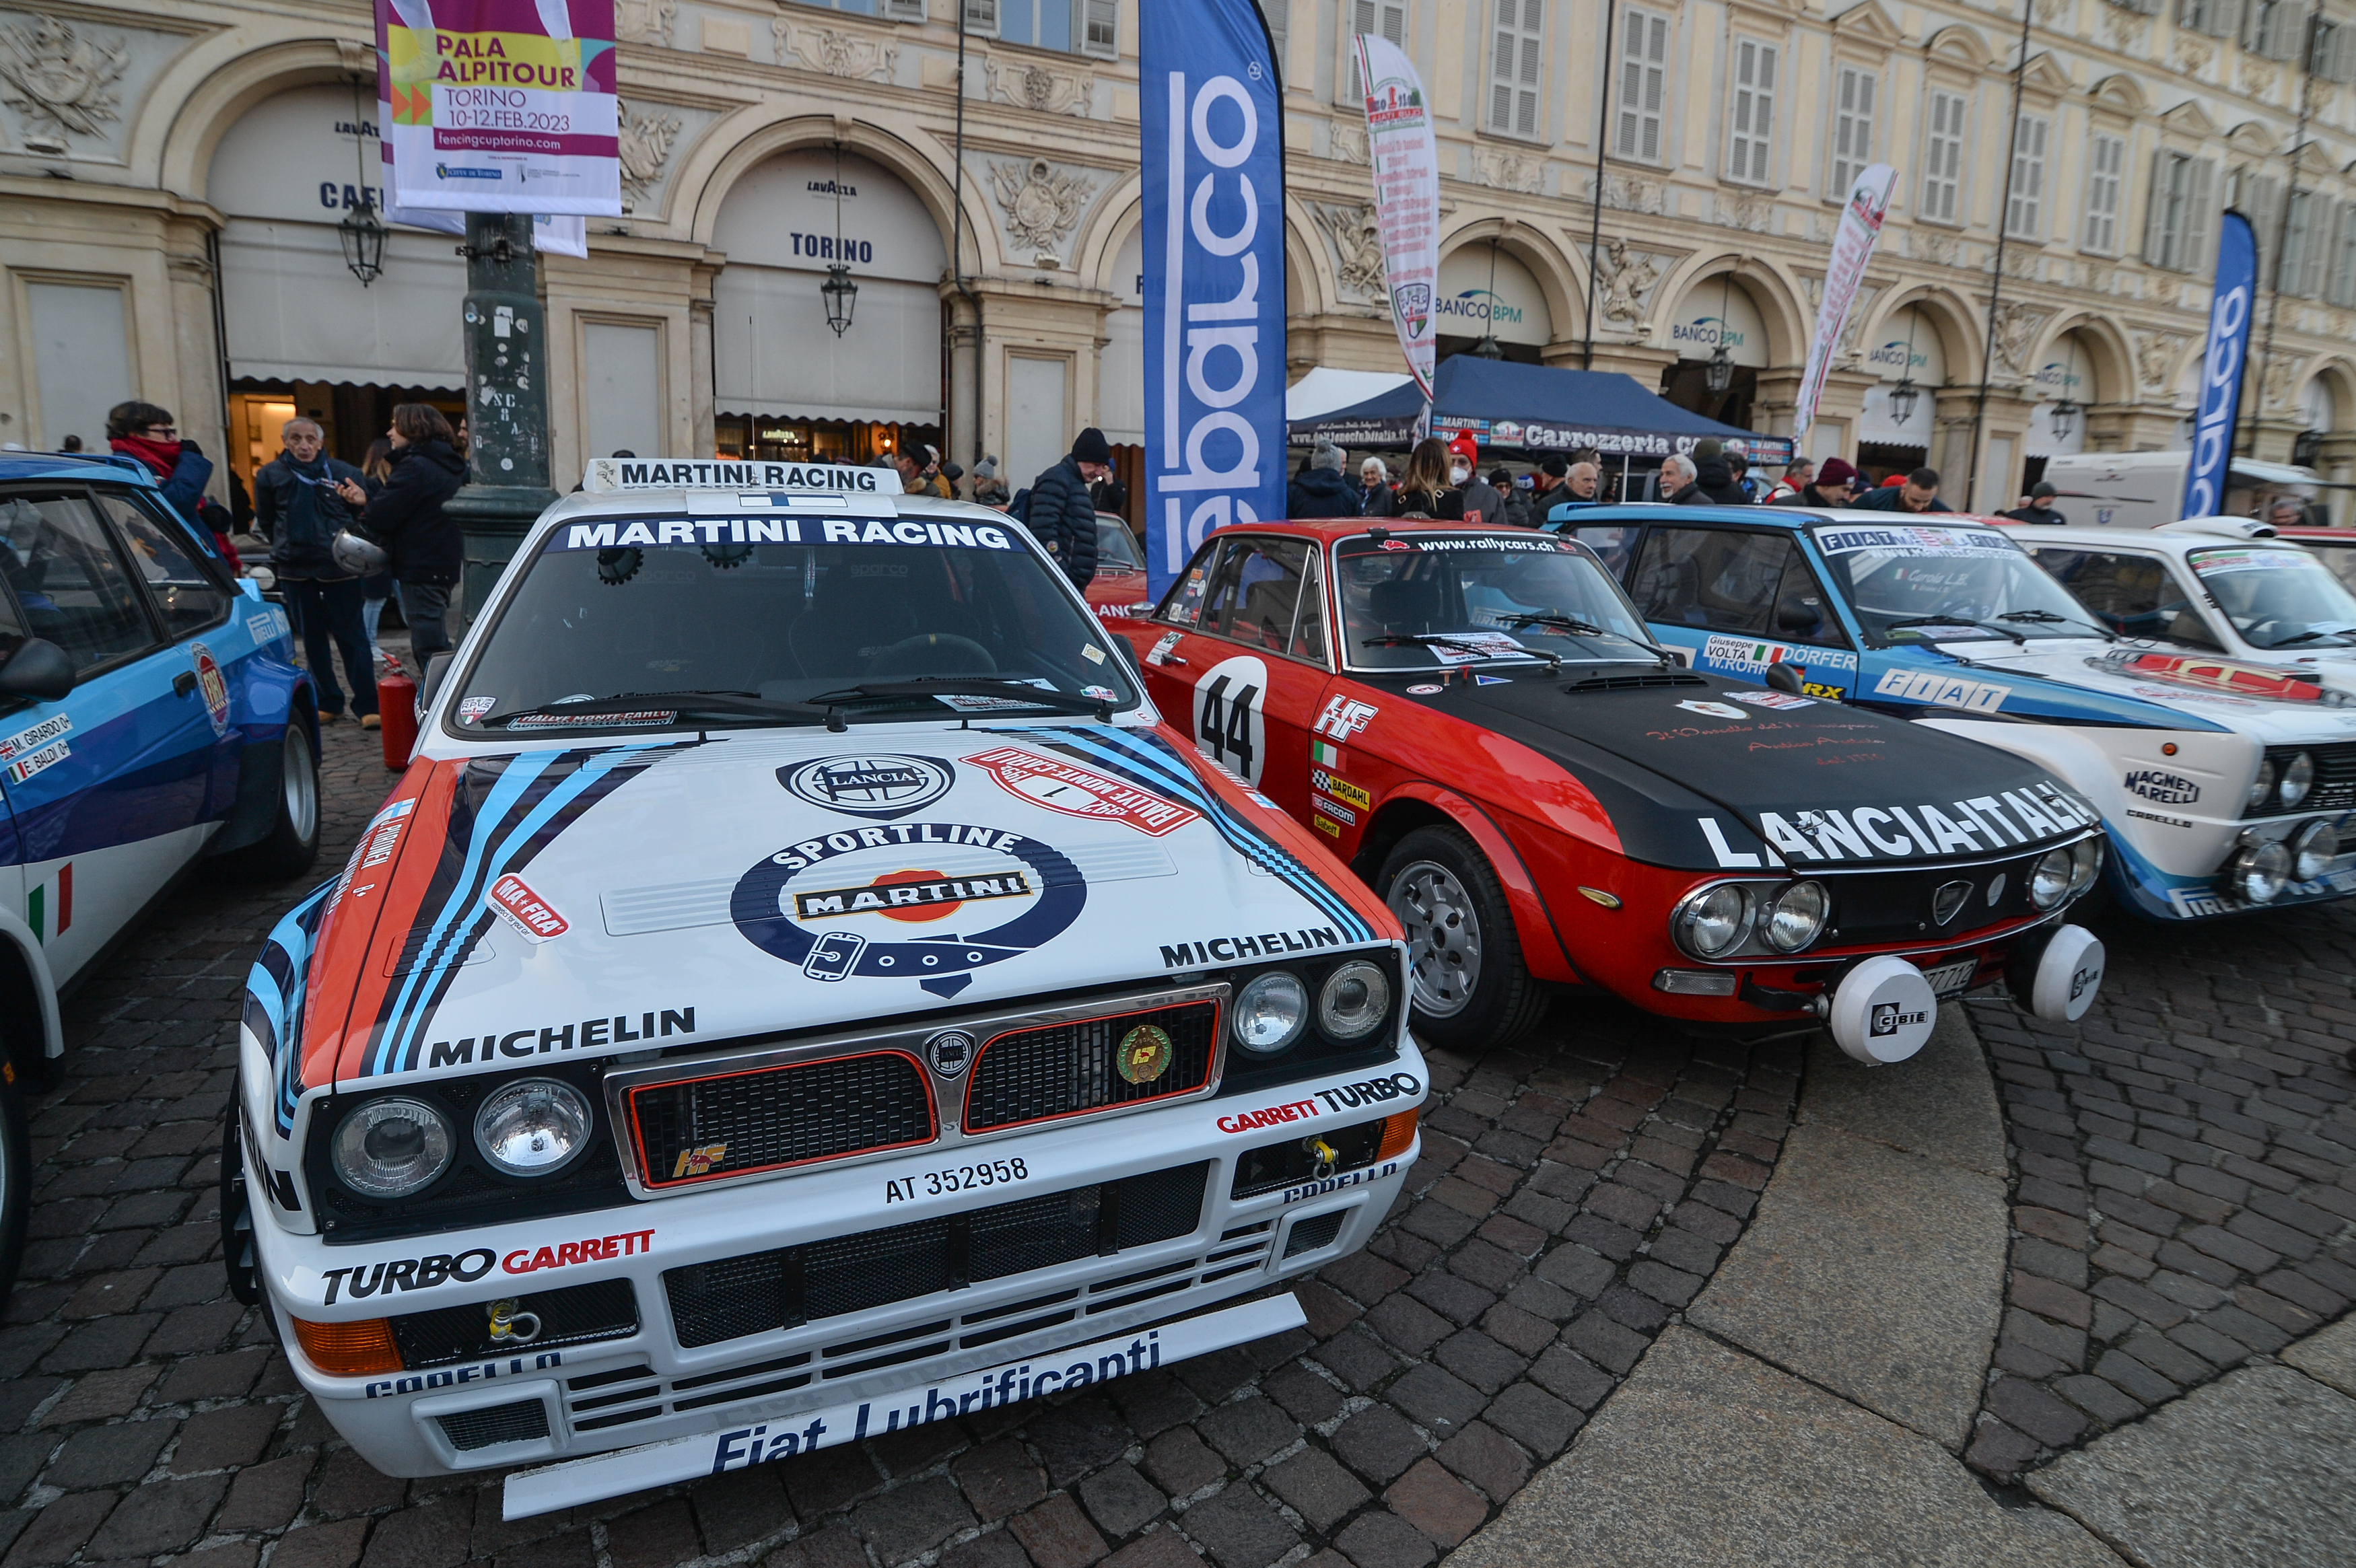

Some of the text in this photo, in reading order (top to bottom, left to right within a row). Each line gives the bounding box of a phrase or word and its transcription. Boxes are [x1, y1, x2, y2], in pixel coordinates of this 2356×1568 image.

[437, 34, 506, 58] PALA
[438, 60, 576, 87] ALPITOUR
[444, 88, 526, 108] TORINO
[449, 110, 569, 132] 10-12.FEB.2023
[438, 133, 561, 151] fencingcuptorino.com
[807, 180, 857, 196] LAVAZZA
[790, 232, 872, 263] TORINO
[1435, 297, 1490, 319] BANCO
[1492, 306, 1523, 324] BPM
[1673, 324, 1744, 346] BANCO BPM
[1441, 416, 1481, 429] MARTINI
[1525, 425, 1670, 454] Carrozzeria
[1757, 441, 1785, 450] MARTINI
[1756, 453, 1784, 462] RACING
[621, 463, 753, 487] MARTINI
[764, 464, 876, 491] RACING
[567, 520, 1010, 549] MARTINI RACING
[1418, 537, 1556, 553] www.rallycars.ch
[1820, 530, 1898, 552] FIAT
[1708, 645, 1746, 660] VOLTA
[1710, 635, 1754, 649] Giuseppe
[1883, 671, 2004, 709] FIAT
[619, 718, 667, 726] TORINO
[1201, 674, 1259, 779] 44
[1314, 694, 1379, 742] HF
[11, 738, 26, 753] M.
[24, 720, 61, 746] GIRARDO
[23, 760, 35, 775] E.
[33, 746, 59, 769] BALDI
[829, 769, 920, 787] LANCIA
[979, 750, 1184, 828] RALLYE MONTE-CARLO
[2124, 770, 2197, 794] MAGNETI
[1041, 785, 1070, 798] 1
[1332, 779, 1368, 806] BARDAHL
[2133, 783, 2201, 804] MARELLI
[1078, 798, 1130, 817] 1992
[2126, 809, 2192, 828] CARELLO
[1315, 816, 1338, 836] Sabelt
[771, 824, 1023, 870] SPORTLINE
[804, 876, 1021, 916] MARTINI
[491, 902, 508, 918] cosmetics
[507, 914, 515, 923] for
[512, 921, 524, 931] your
[1158, 927, 1340, 968] MICHELIN
[428, 1006, 696, 1069] MICHELIN
[941, 1050, 963, 1059] LANCIA
[1132, 1046, 1156, 1065] HF
[1216, 1072, 1421, 1135] GARRETT TURBO
[672, 1142, 728, 1178] HF
[885, 1157, 1030, 1205] AT 352958
[321, 1228, 656, 1306] TURBO GARRETT
[712, 1330, 1160, 1474] Fiat Lubrificanti
